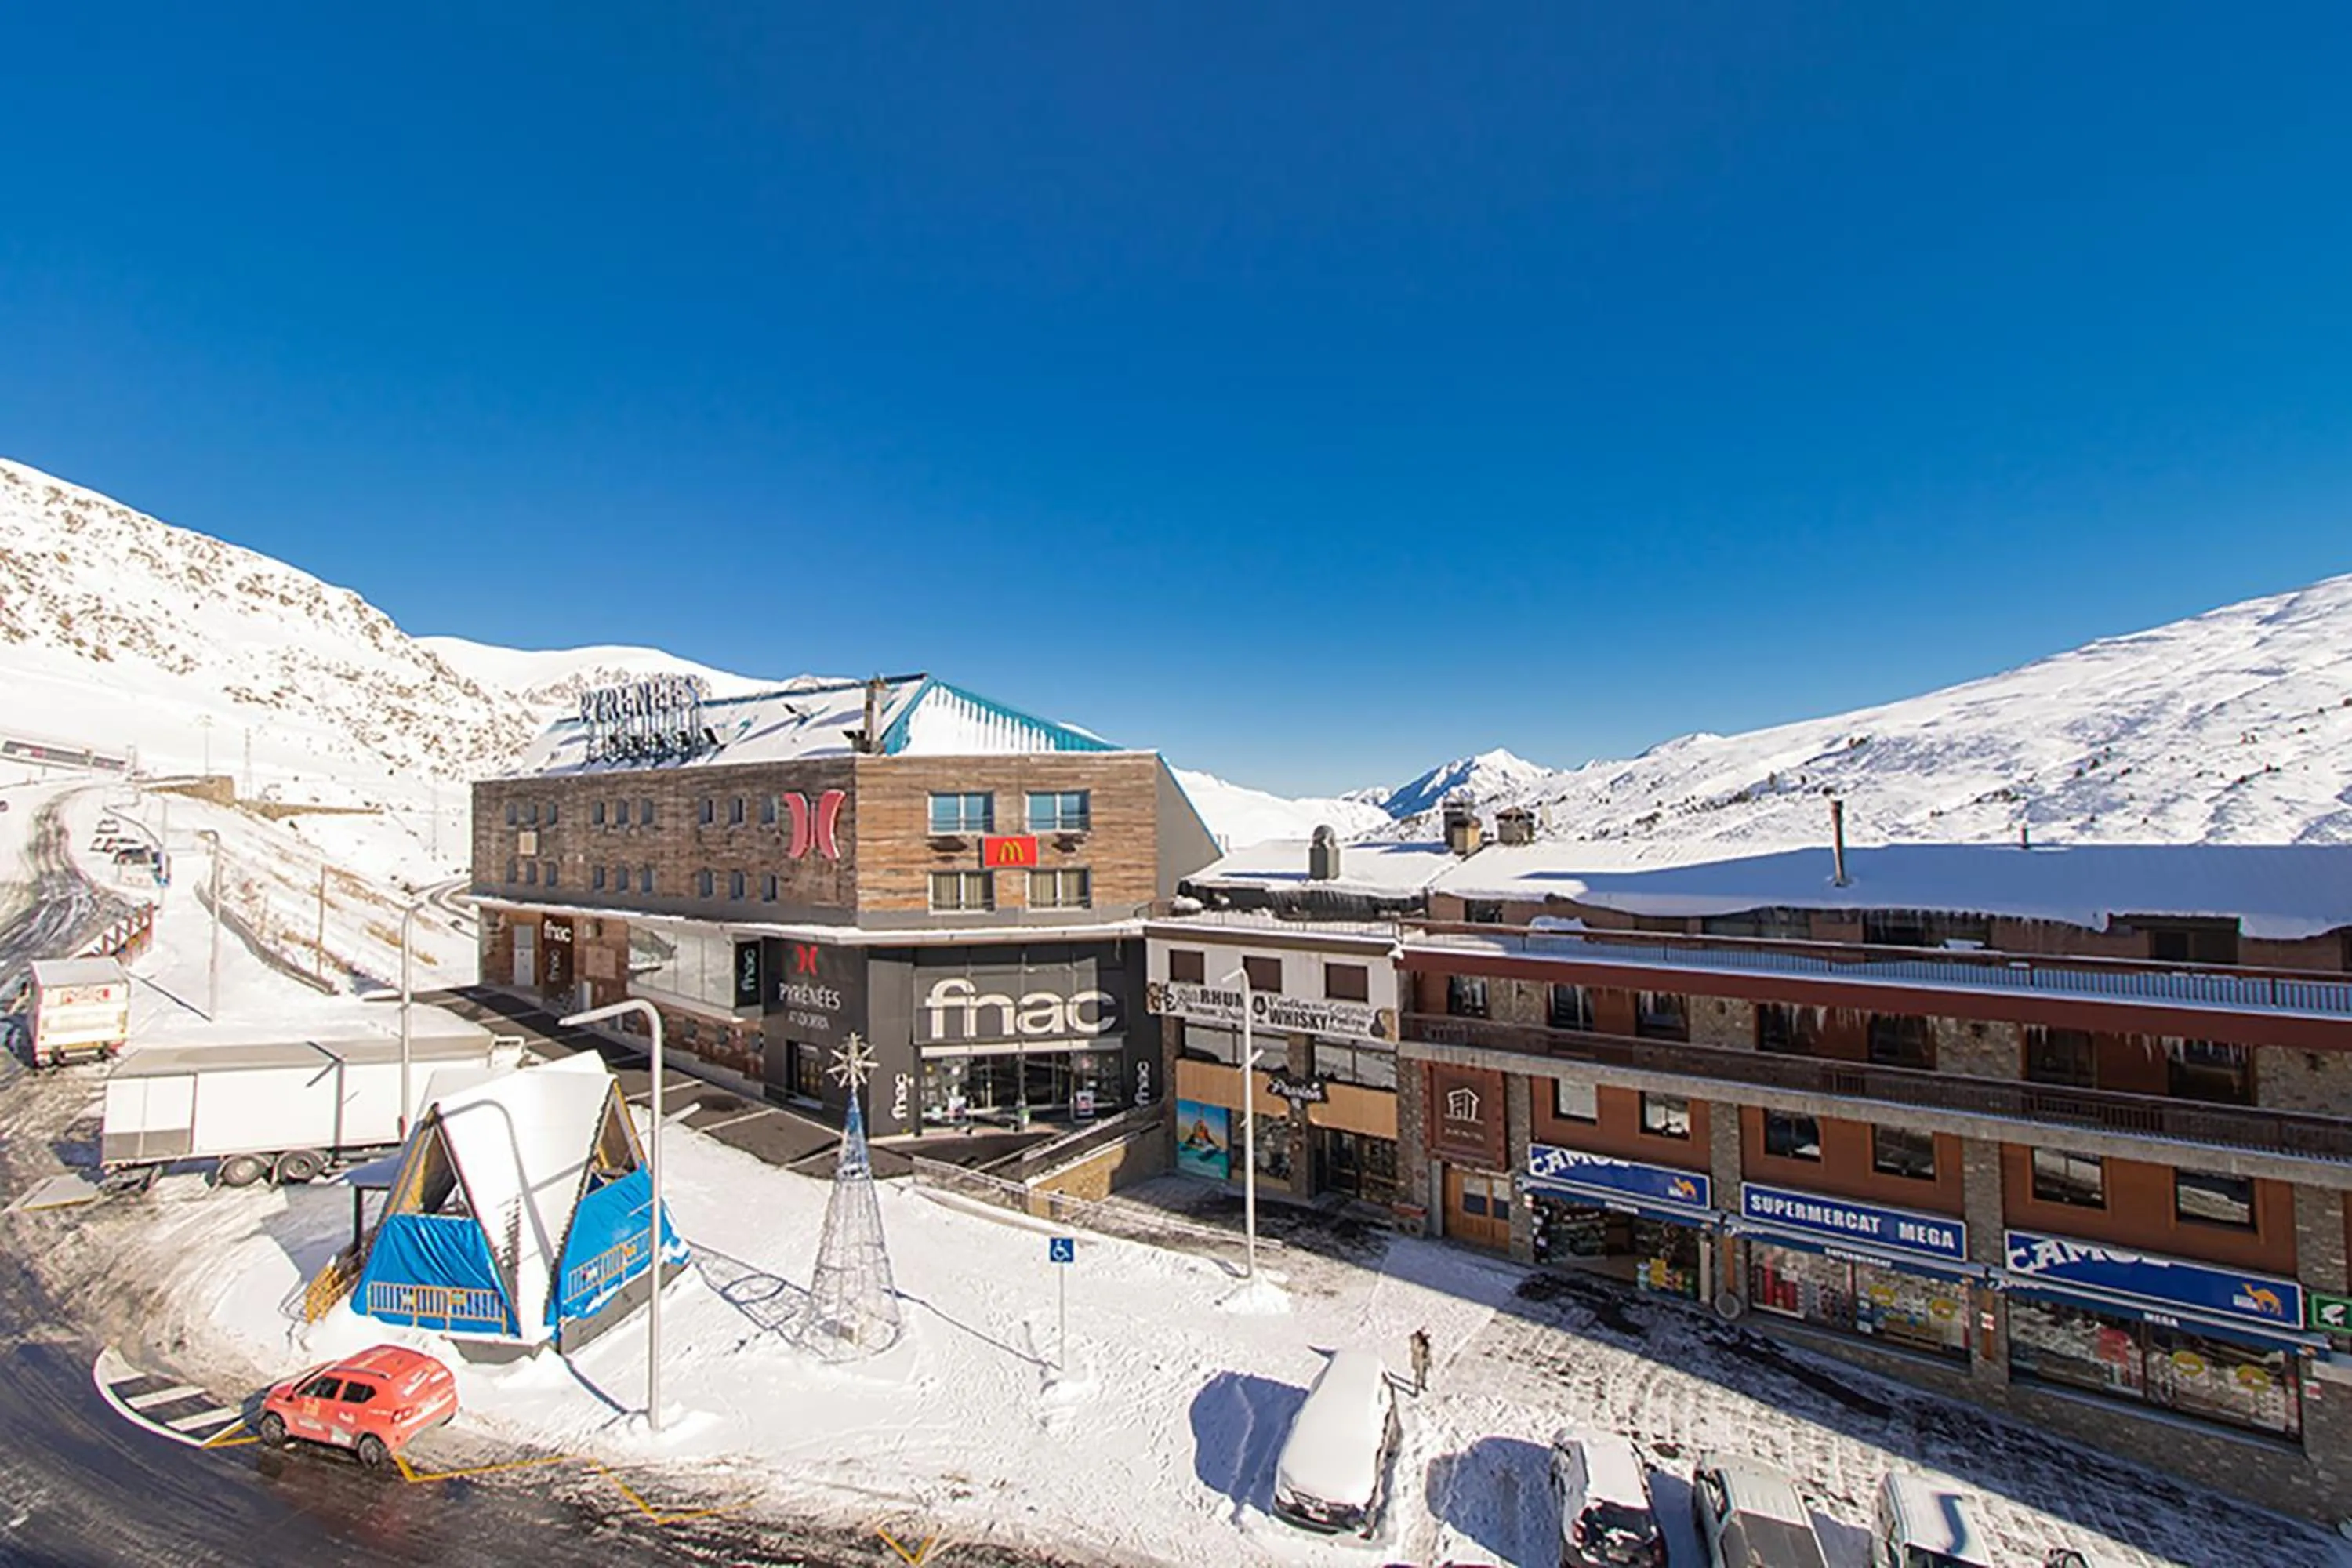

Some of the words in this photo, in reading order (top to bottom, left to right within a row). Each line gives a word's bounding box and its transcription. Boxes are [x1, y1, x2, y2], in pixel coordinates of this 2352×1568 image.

[740, 949, 756, 991] fnac
[925, 978, 1116, 1039] fnac
[1268, 1009, 1328, 1031] WHISKY
[891, 1073, 907, 1120] fnac
[1134, 1060, 1149, 1107] fnac
[1530, 1149, 1631, 1176] CAM
[1750, 1193, 1882, 1235] SUPERMERCAT
[1898, 1221, 1955, 1250] MEGA
[2008, 1237, 2172, 1273] CAM
